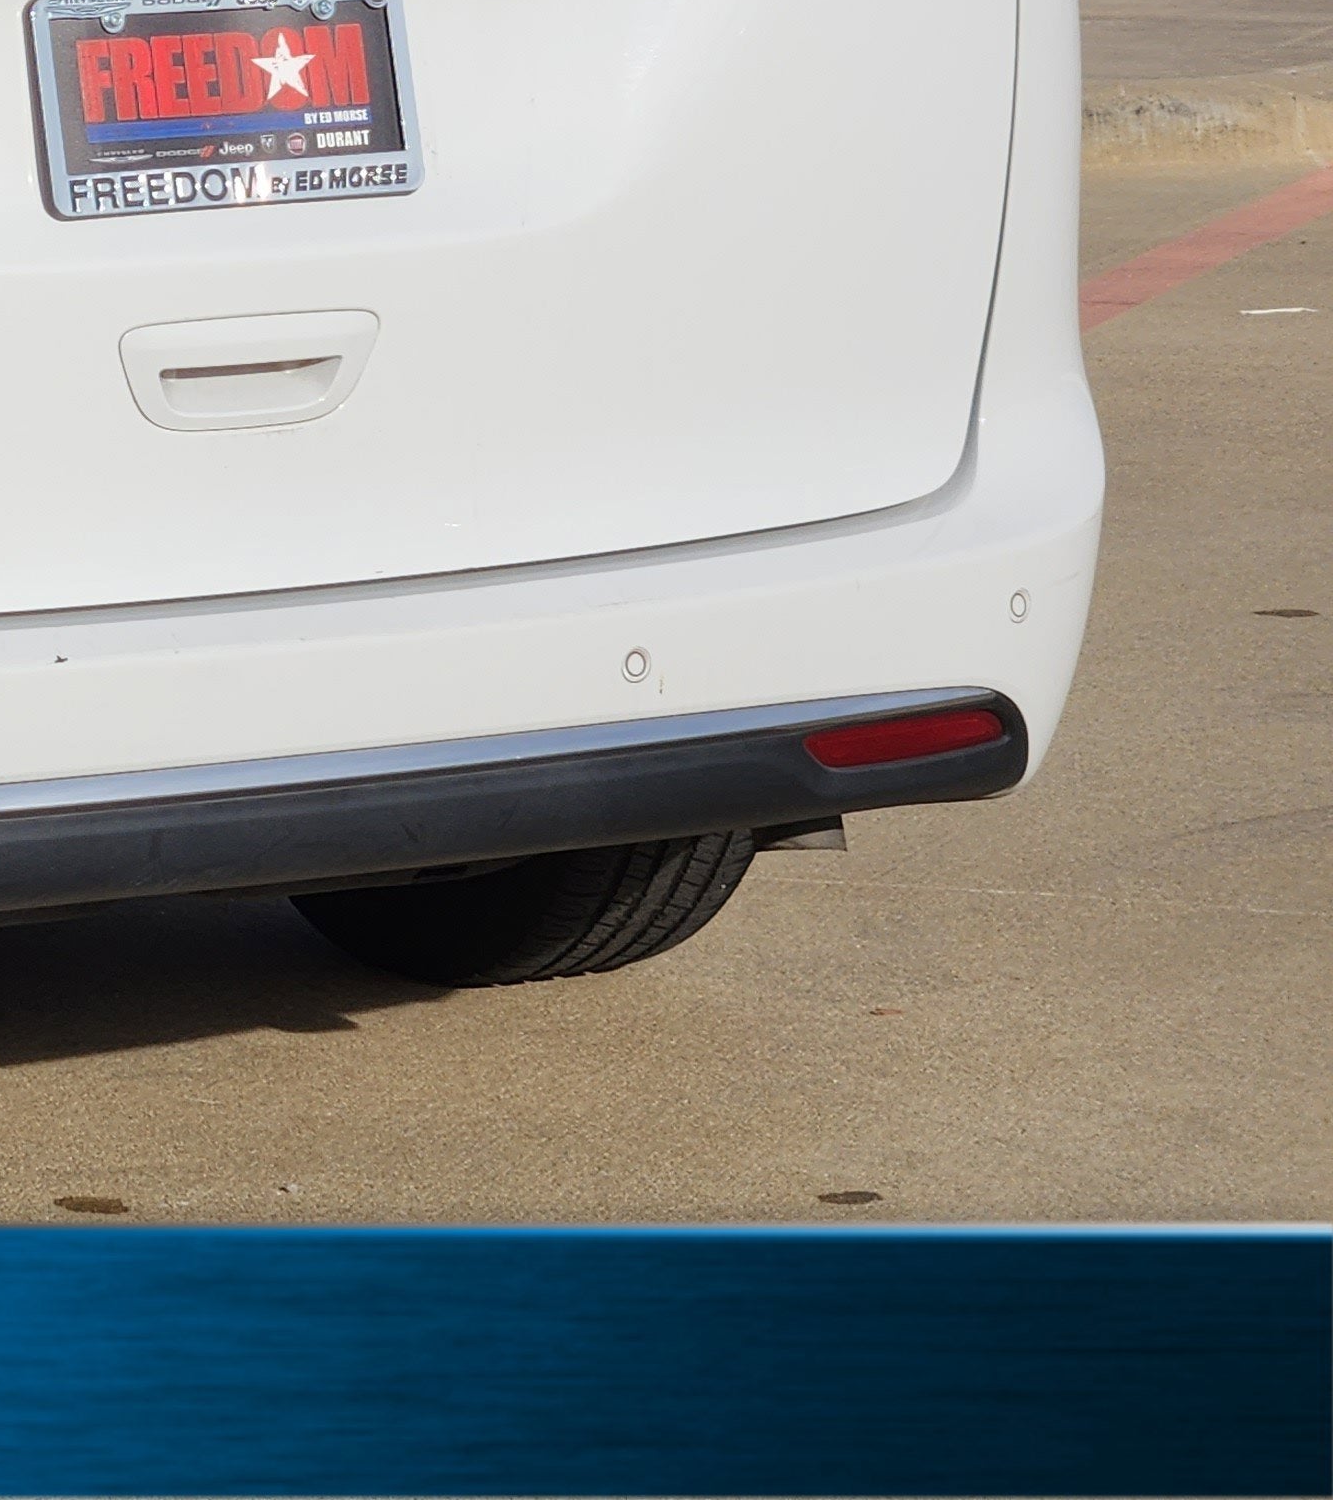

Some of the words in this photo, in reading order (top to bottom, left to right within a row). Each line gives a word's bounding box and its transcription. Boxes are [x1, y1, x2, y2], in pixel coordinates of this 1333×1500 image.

[77, 23, 371, 123] FREEDOM
[304, 112, 318, 125] BY
[319, 111, 333, 124] ED
[334, 109, 370, 123] MORSE
[219, 141, 254, 157] Jeep
[316, 129, 371, 149] DURANT
[295, 169, 323, 192] ED
[328, 162, 408, 190] MORSE
